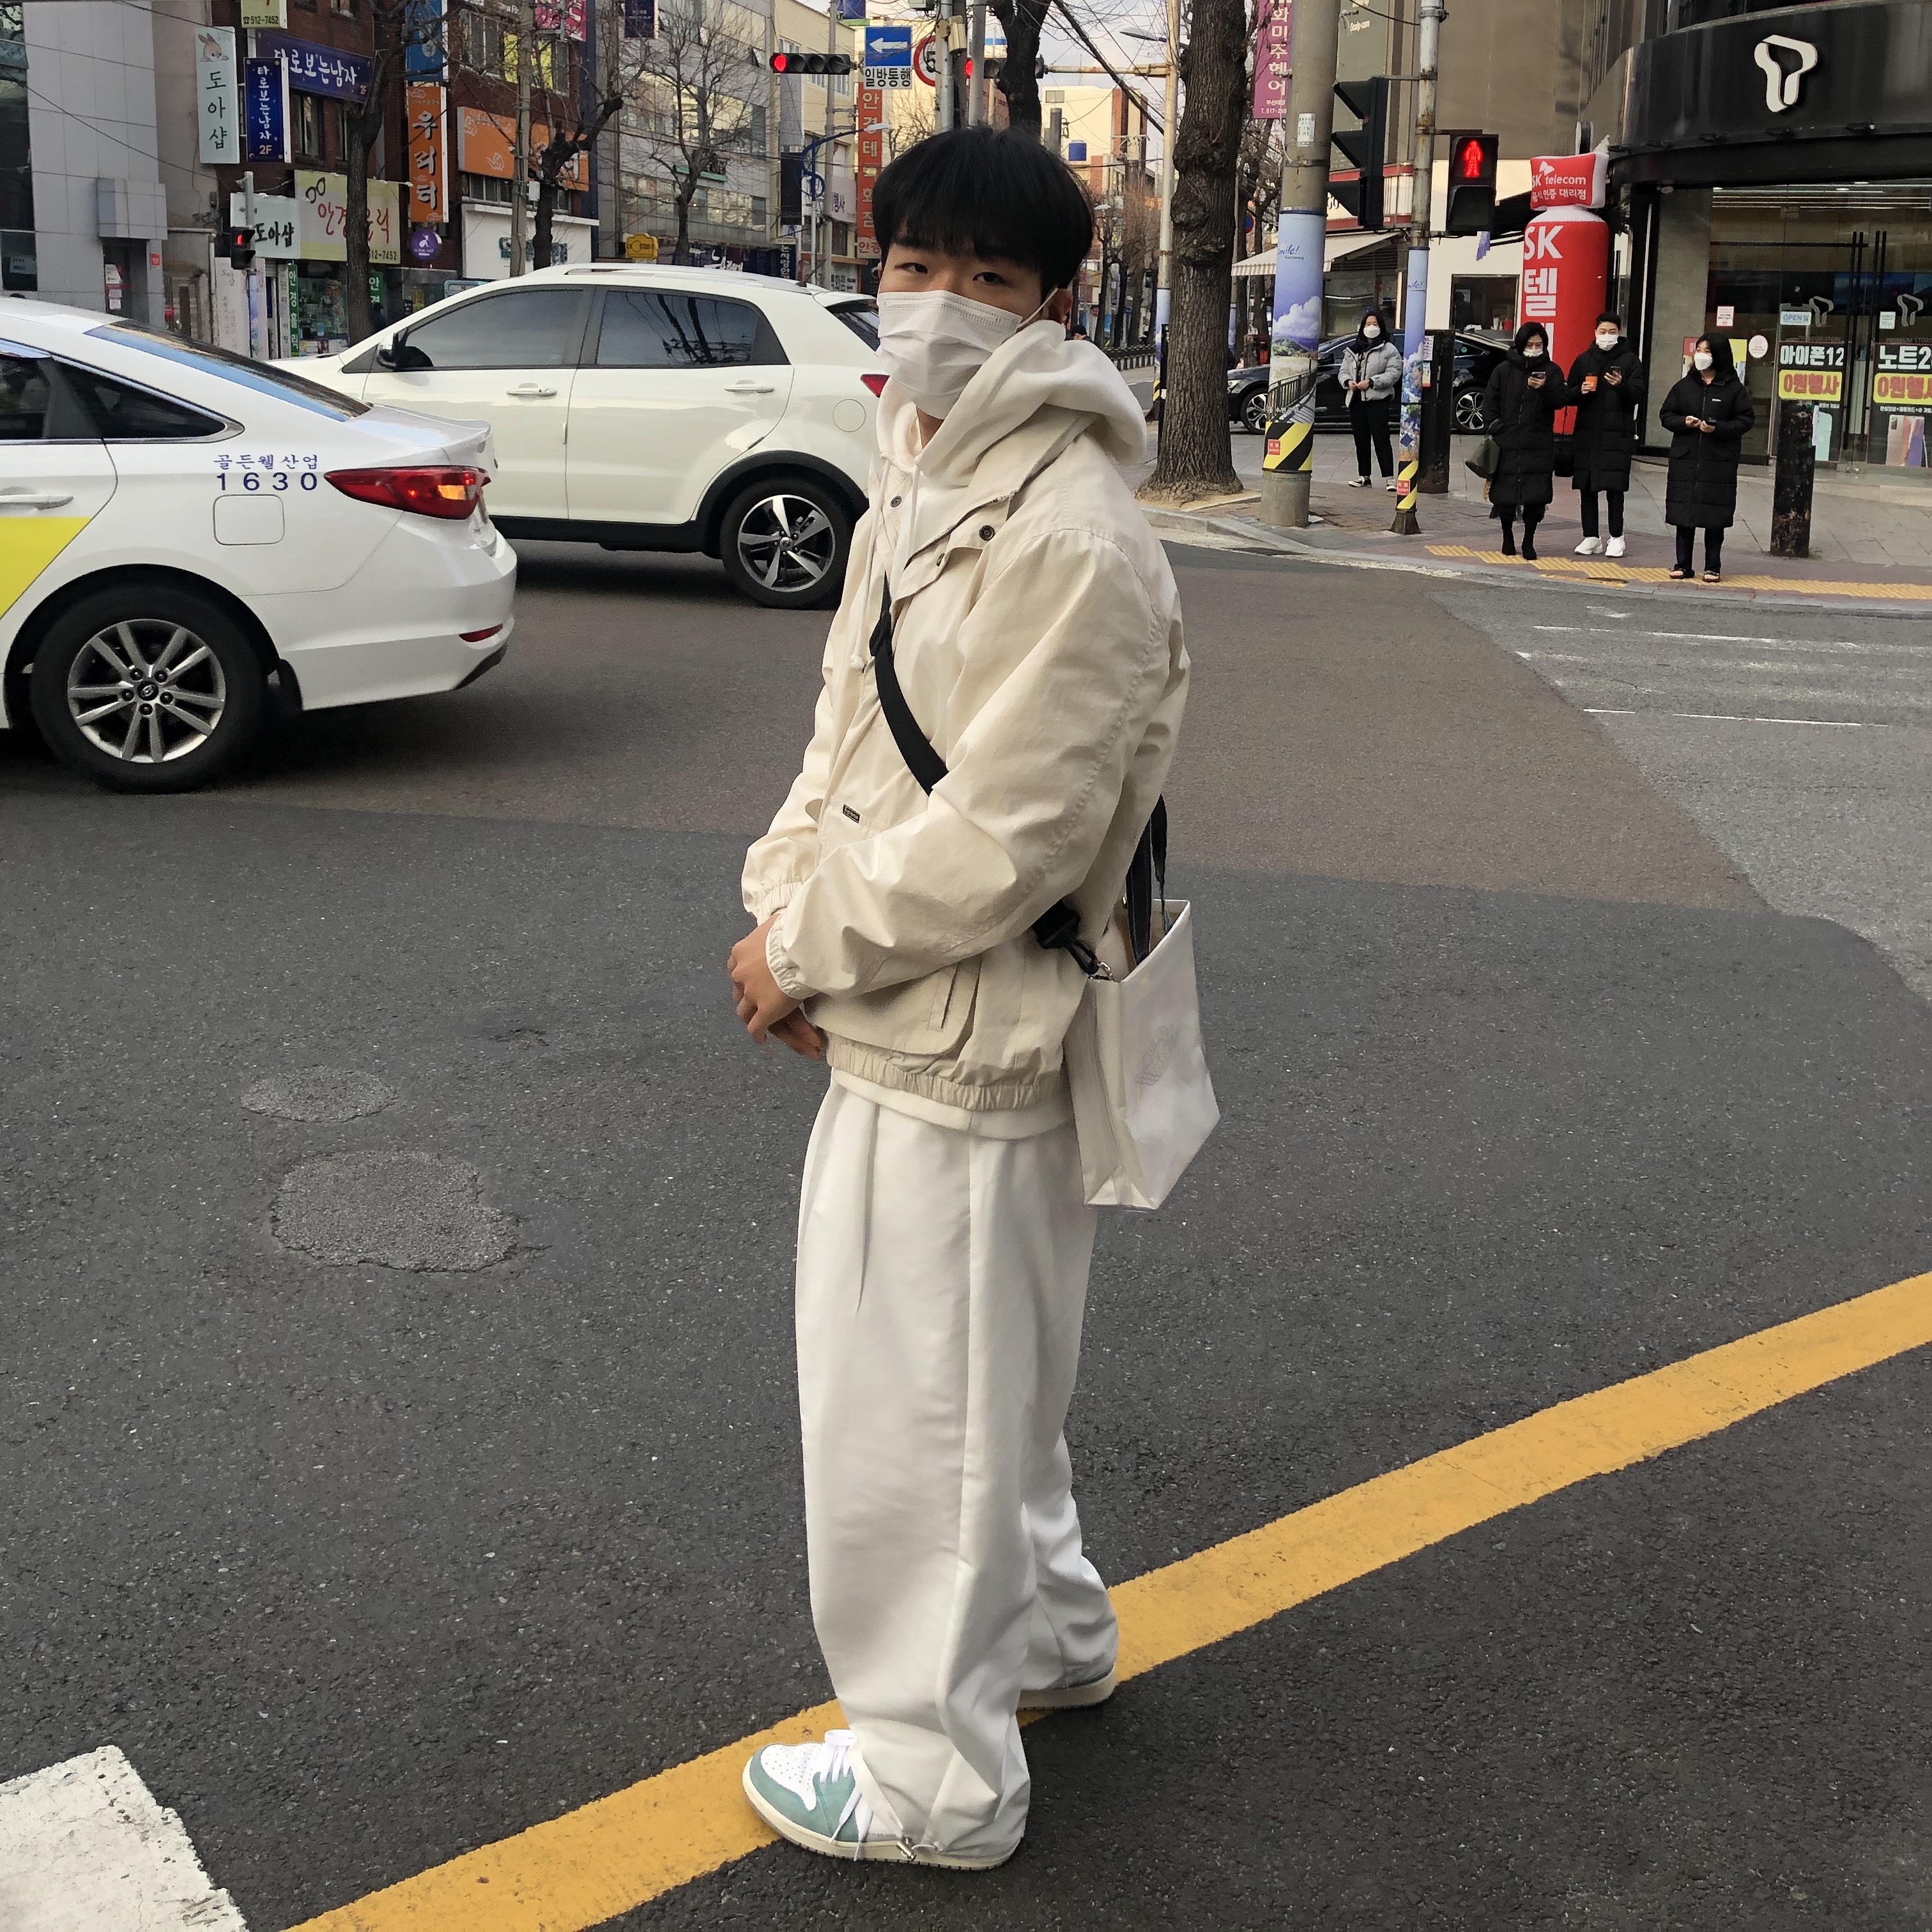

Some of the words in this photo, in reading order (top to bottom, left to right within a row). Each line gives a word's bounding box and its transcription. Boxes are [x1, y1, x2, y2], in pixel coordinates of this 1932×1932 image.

[251, 15, 279, 25] 512-7452
[864, 67, 911, 88] 일방통행
[206, 71, 227, 150] 도아샵
[257, 65, 272, 141] 타로보는남자
[259, 145, 272, 155] 2F
[1545, 173, 1586, 185] telecom
[1559, 188, 1586, 201] 대리점
[253, 220, 295, 249] 도아샵
[1524, 225, 1564, 261] SK
[369, 249, 397, 261] 12-7452
[1780, 345, 1844, 366] 아이폰12
[1878, 345, 1932, 370] 노트2
[1783, 373, 1840, 396] 0원행사
[217, 472, 318, 491] 1630
